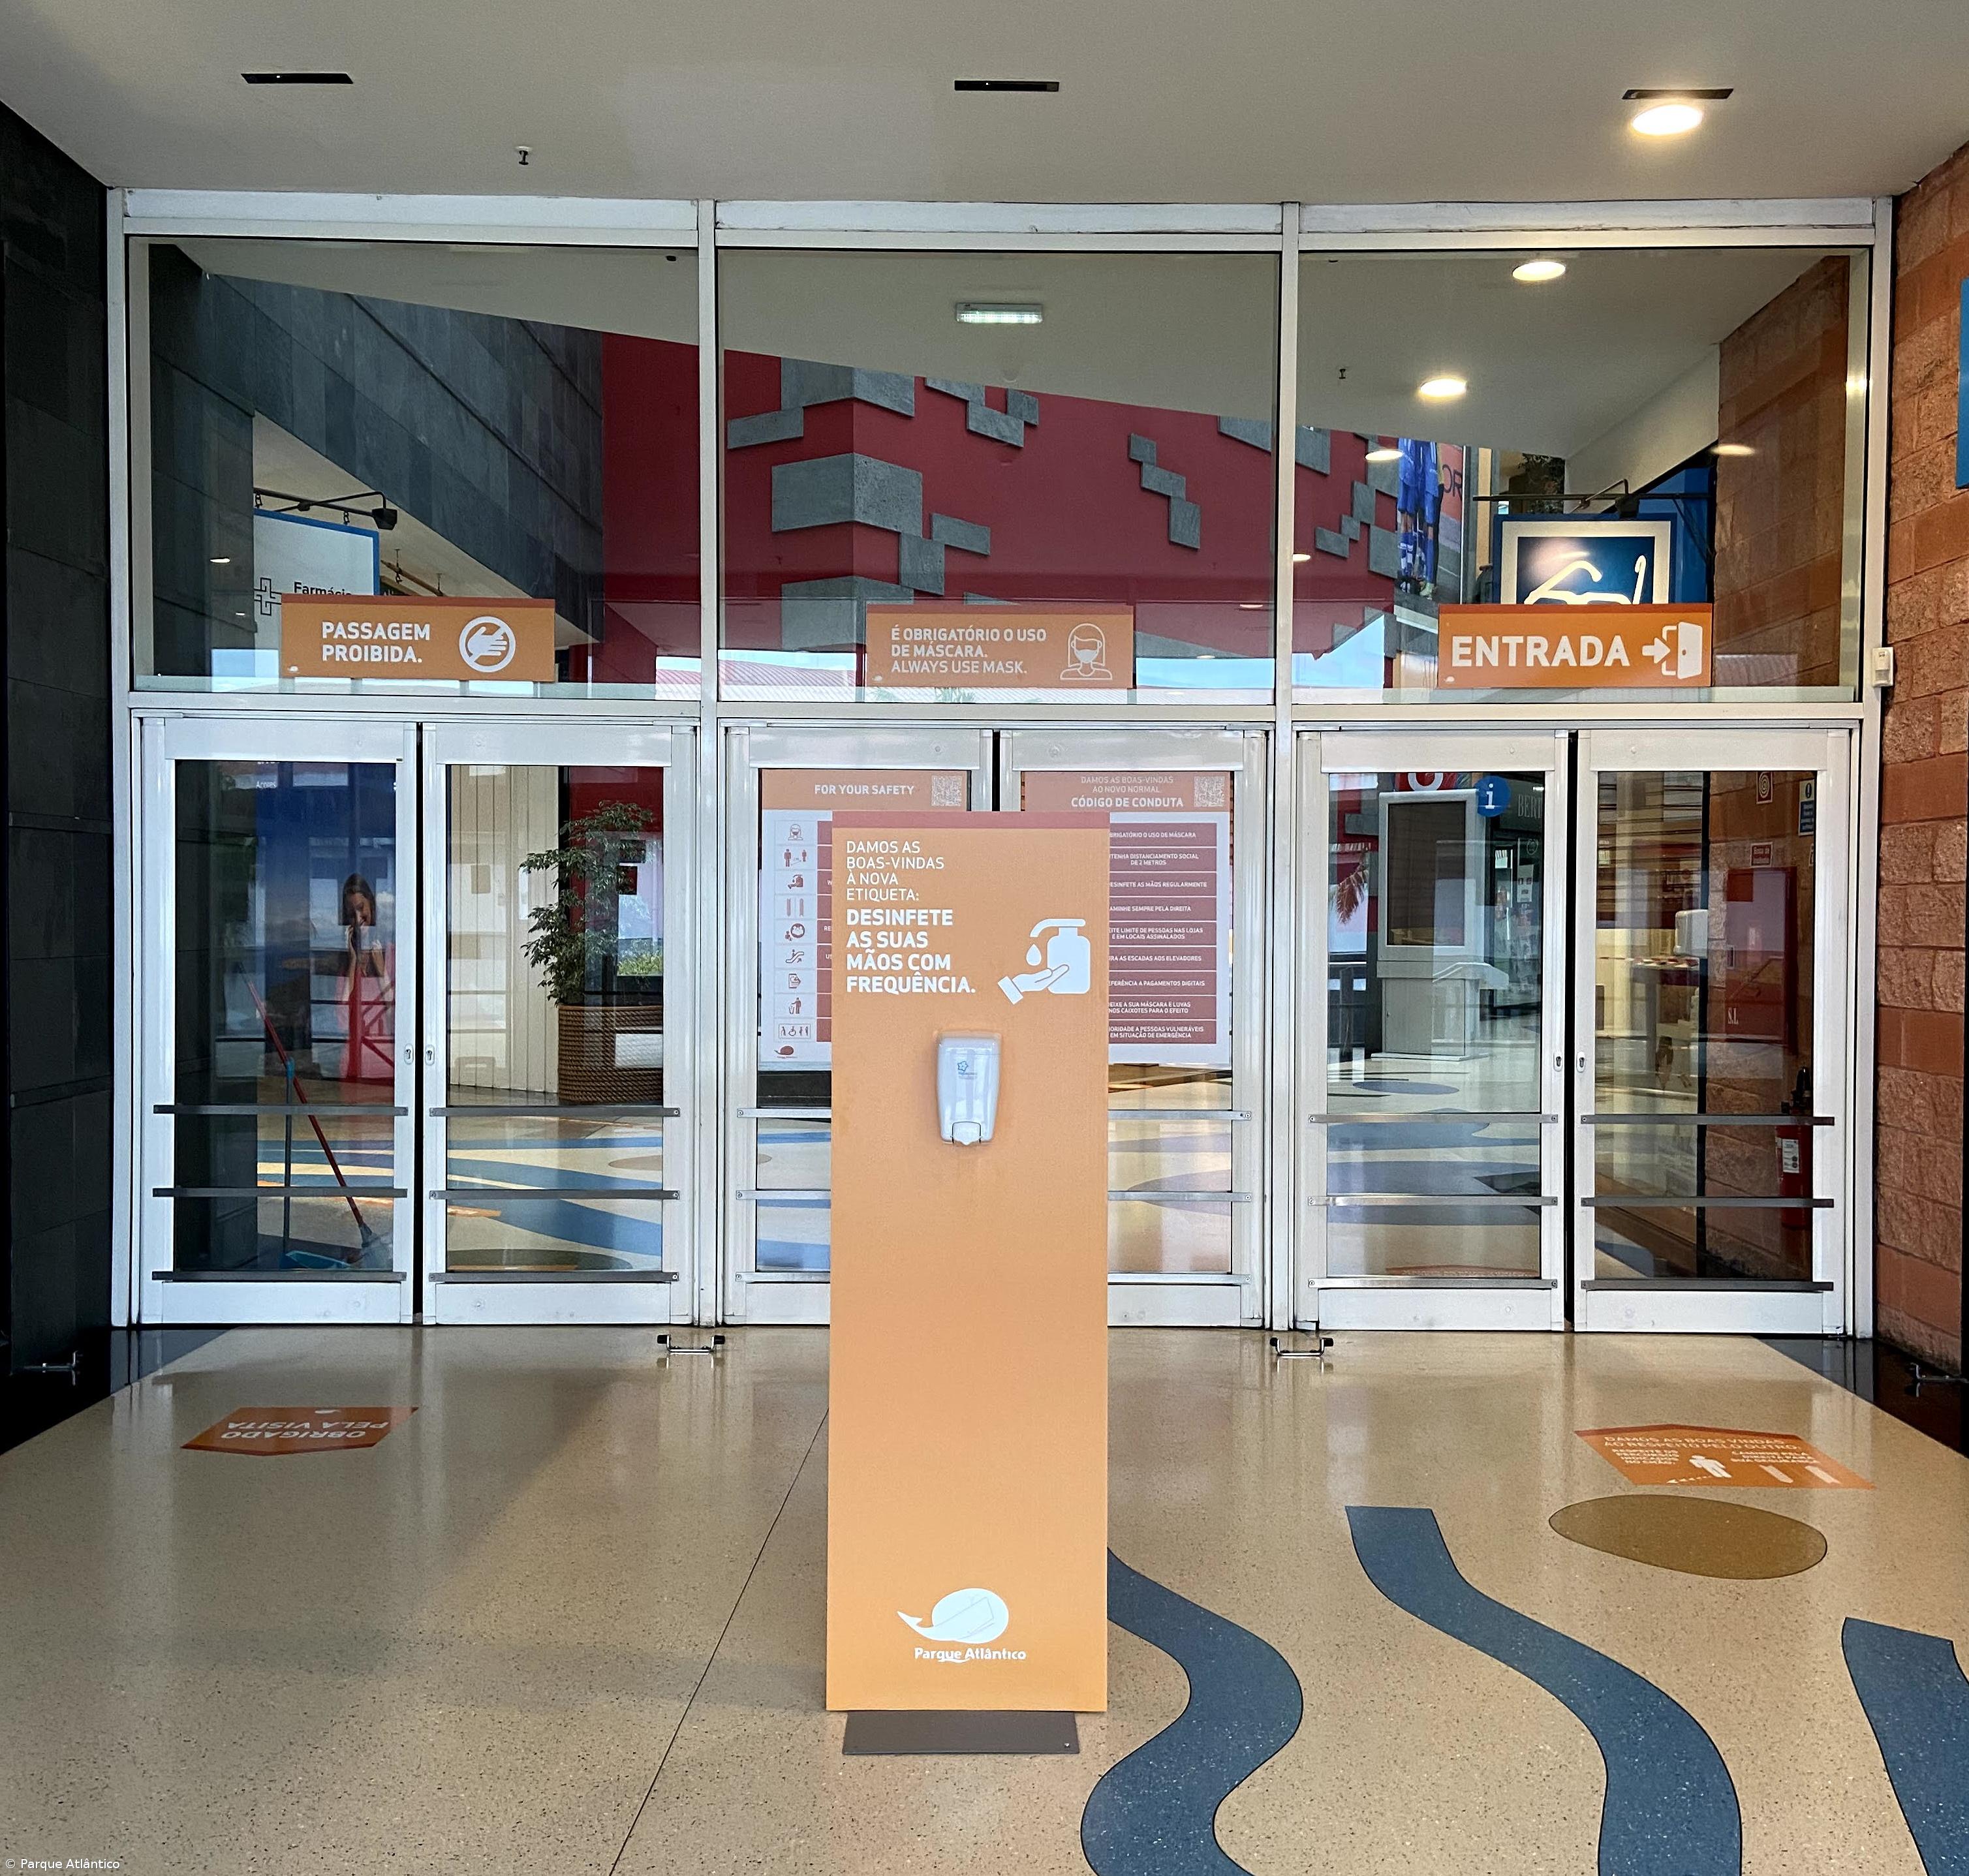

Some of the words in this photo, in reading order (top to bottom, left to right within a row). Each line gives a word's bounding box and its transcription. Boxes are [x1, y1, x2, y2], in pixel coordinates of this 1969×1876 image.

[322, 621, 431, 641] PASSAGEM
[891, 624, 899, 641] É
[903, 624, 999, 641] OBRIGATÓRIO
[1004, 628, 1014, 641] O
[1017, 628, 1046, 641] USO
[322, 645, 423, 663] PROIBIDA.
[891, 645, 910, 657] DE
[914, 641, 987, 658] MÁSCARA.
[1451, 636, 1630, 667] ENTRADA
[891, 661, 948, 673] ALWAYS
[952, 661, 978, 673] USE
[982, 661, 1027, 674] MASK.
[814, 785, 836, 795] FOR
[839, 785, 869, 795] YOUR
[872, 785, 914, 795] SAFETY
[1071, 795, 1112, 807] CÓDIGO
[1115, 797, 1130, 807] DE
[1132, 797, 1183, 807] CONDUTA
[846, 840, 898, 853] DAMOS
[902, 840, 920, 853] AS
[846, 856, 944, 869] BOAS-VINDAS
[846, 869, 856, 885] À
[860, 872, 899, 885] NOVA
[846, 888, 920, 902] ETIQUETA:
[846, 908, 953, 926] DESINFETE
[846, 930, 872, 948] AS
[876, 930, 928, 948] SUAS
[846, 948, 903, 970] MÃOS
[908, 953, 951, 971] COM
[846, 971, 976, 995] FREQUÊNCIA.
[228, 1421, 310, 1430] VISITA
[322, 1421, 390, 1430] PELA
[914, 1648, 965, 1663] Parque
[965, 1648, 1027, 1660] Atlântico
